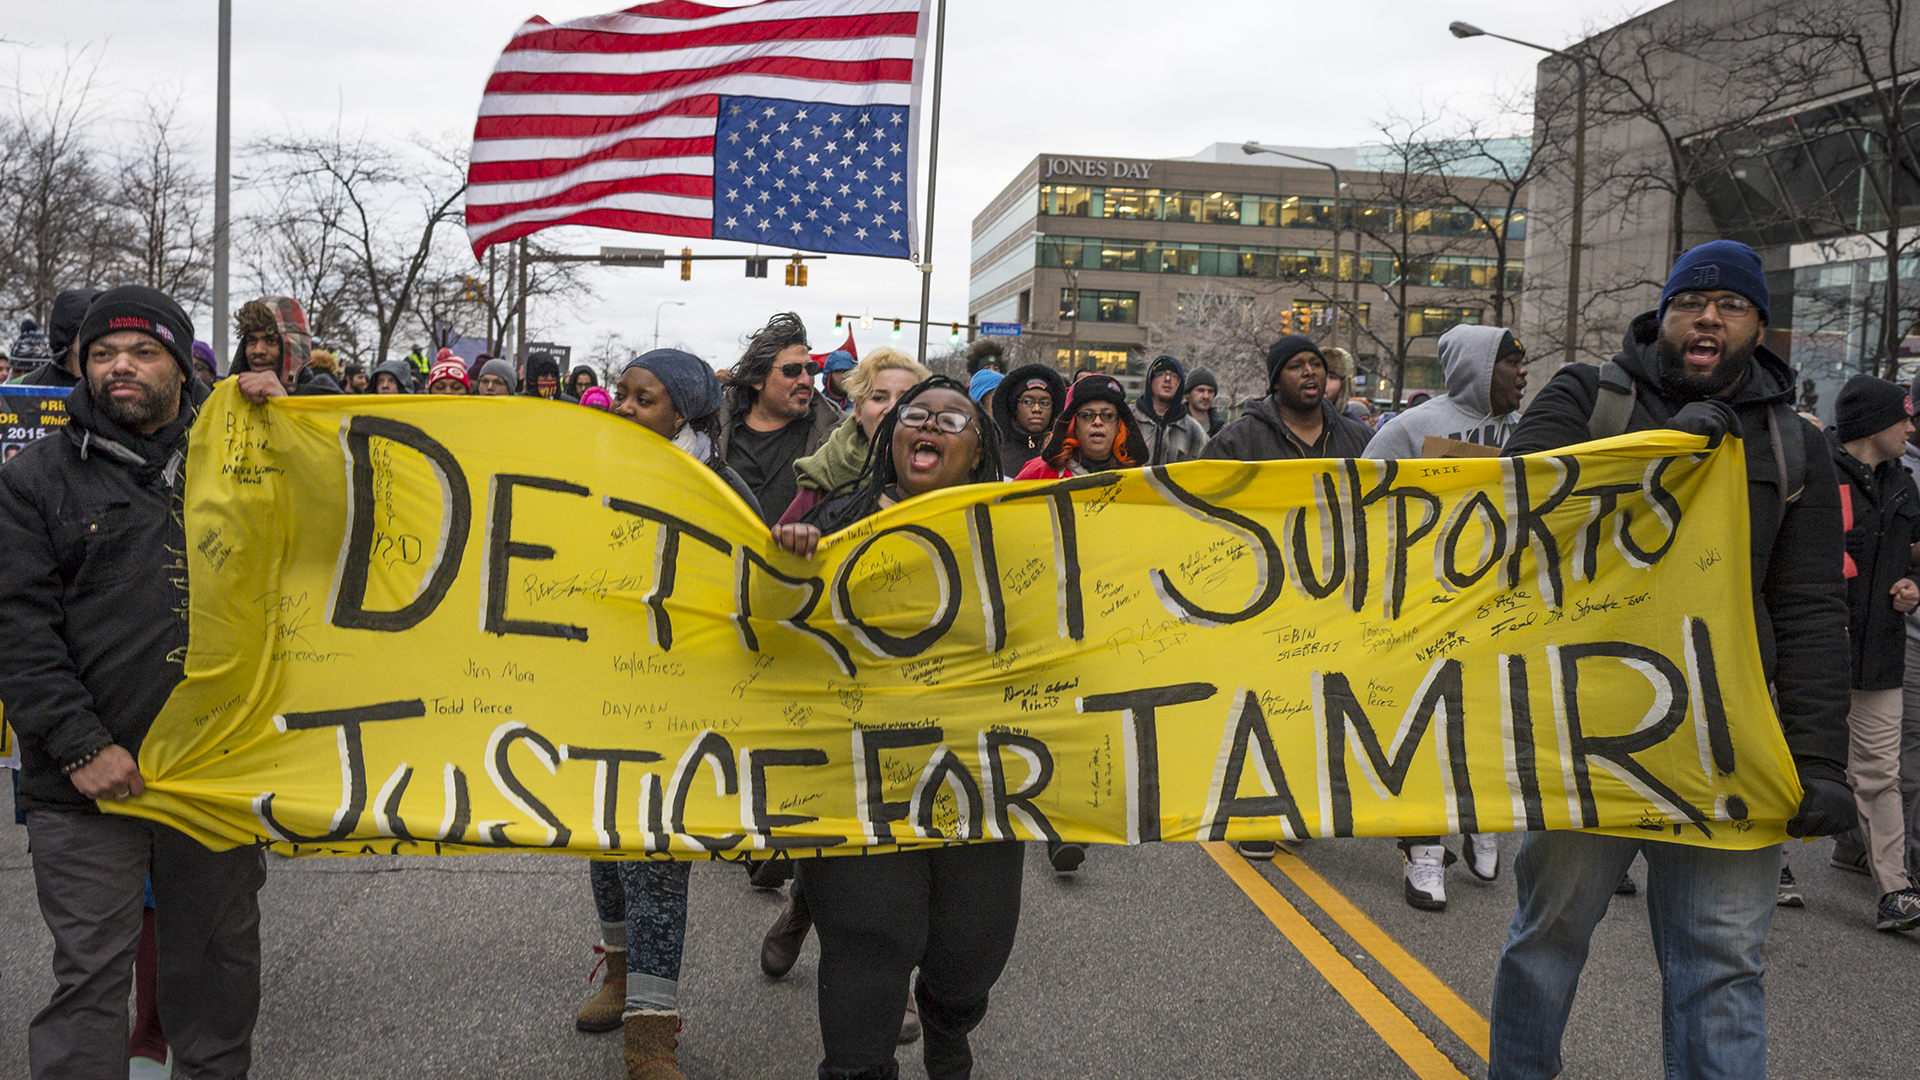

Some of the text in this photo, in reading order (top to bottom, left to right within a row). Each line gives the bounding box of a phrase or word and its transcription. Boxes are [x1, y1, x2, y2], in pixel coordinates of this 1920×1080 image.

[1045, 158, 1152, 179] JONES DAY
[983, 325, 1018, 335] Lakeside
[1420, 465, 1461, 478] IRIE
[326, 414, 1124, 679] DETROIT
[1143, 456, 1690, 626] SUPPORTS
[463, 658, 535, 683] Jim Mora
[613, 652, 645, 678] Kayla
[1366, 677, 1394, 693] Kevin
[430, 696, 513, 716] Todd Pierce
[253, 699, 848, 850] JUSTICE
[852, 727, 1060, 846] FOR
[1076, 614, 1748, 842] TAMIR!
